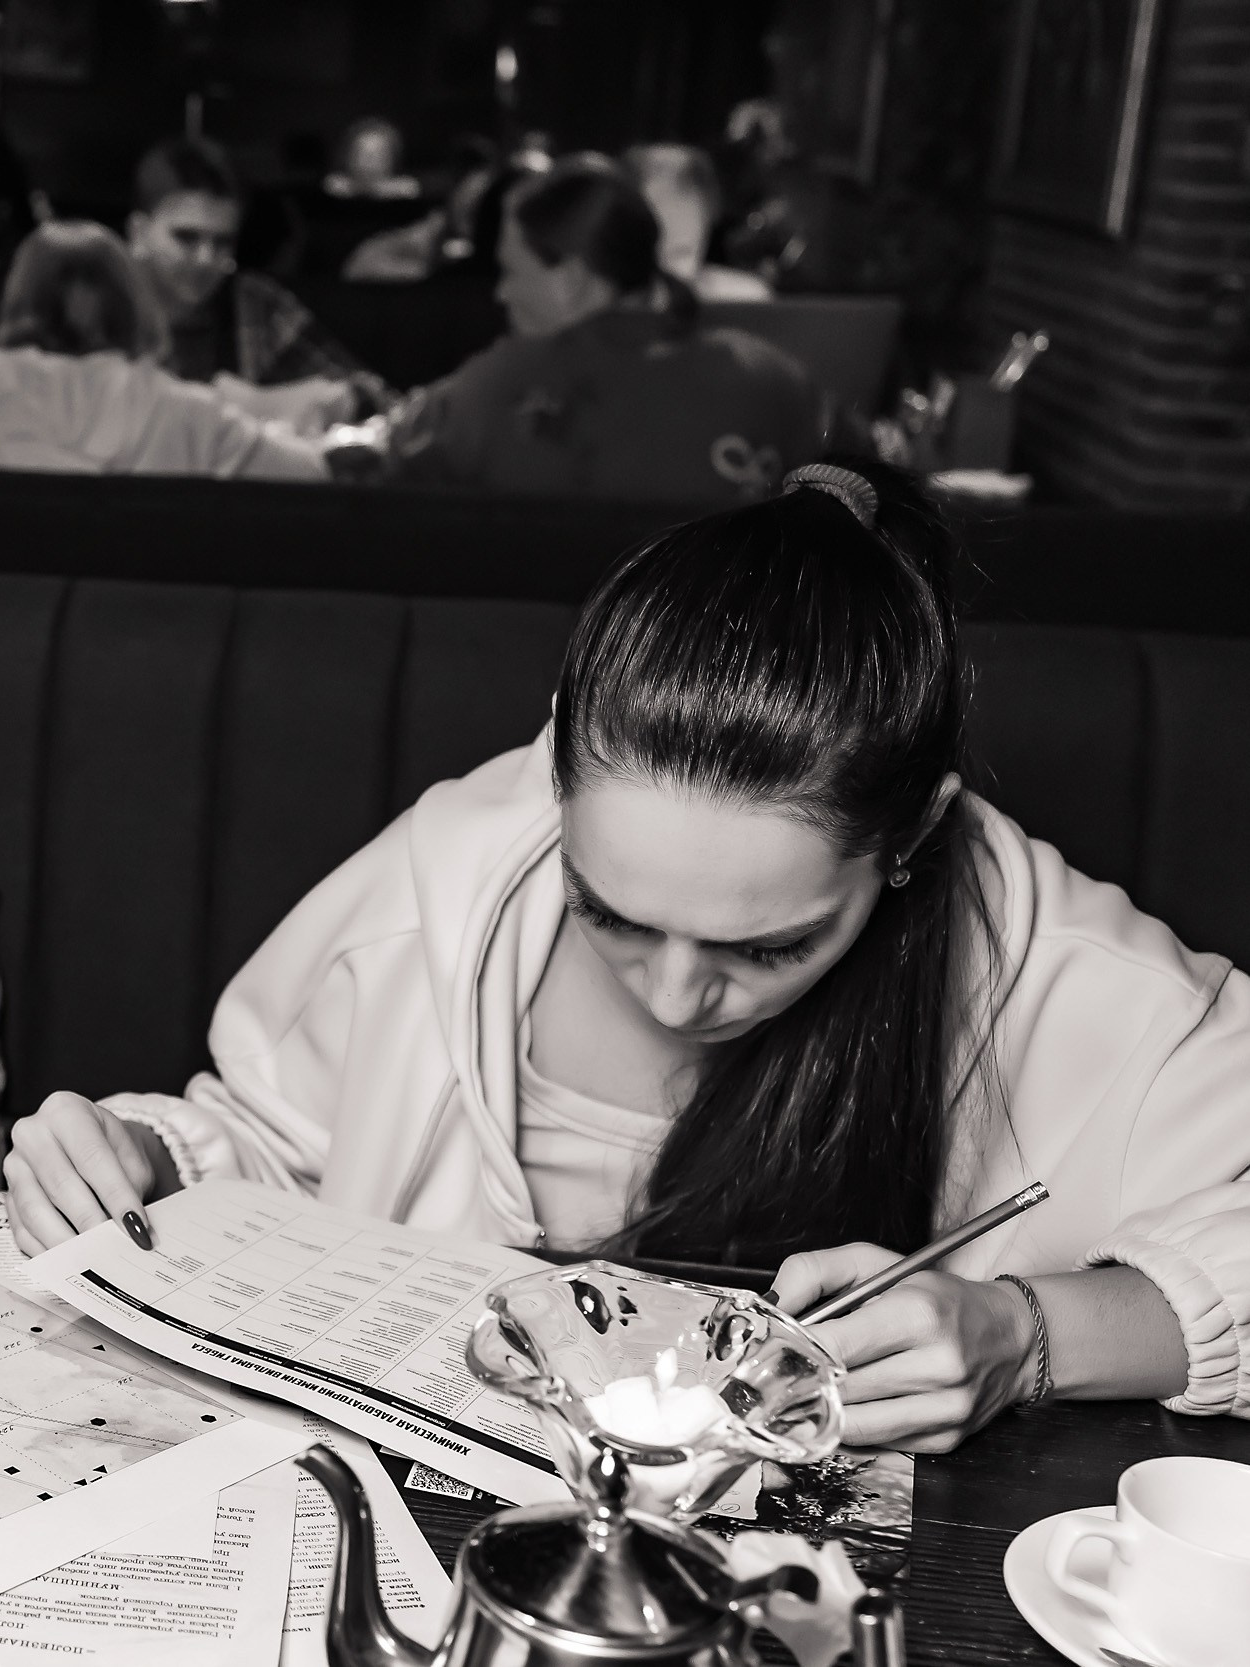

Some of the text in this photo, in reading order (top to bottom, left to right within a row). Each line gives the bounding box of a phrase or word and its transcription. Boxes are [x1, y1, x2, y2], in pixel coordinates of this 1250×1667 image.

[3, 1340, 21, 1351] 322
[191, 1341, 471, 1456] ХИМИЧЕСКАЯ ЛАБОРАТОРИЯ ИМЕНИ ВИЛЬЯМА ГИББСА
[228, 1532, 251, 1540] само
[100, 1555, 145, 1565] пробелов
[57, 1566, 90, 1575] любом
[120, 1565, 180, 1577] учреждения
[167, 1563, 209, 1572] пишутся
[212, 1567, 244, 1576] Имена
[101, 1572, 151, 1582] запросить
[153, 1577, 185, 1585] хотите
[205, 1582, 229, 1590] Если
[122, 1597, 173, 1608] городской
[132, 1606, 156, 1615] Если
[177, 1603, 238, 1614] ближайший
[6, 1610, 41, 1619] районе
[114, 1622, 174, 1632] управление
[189, 1620, 219, 1628] район
[178, 1628, 219, 1638] Главное
